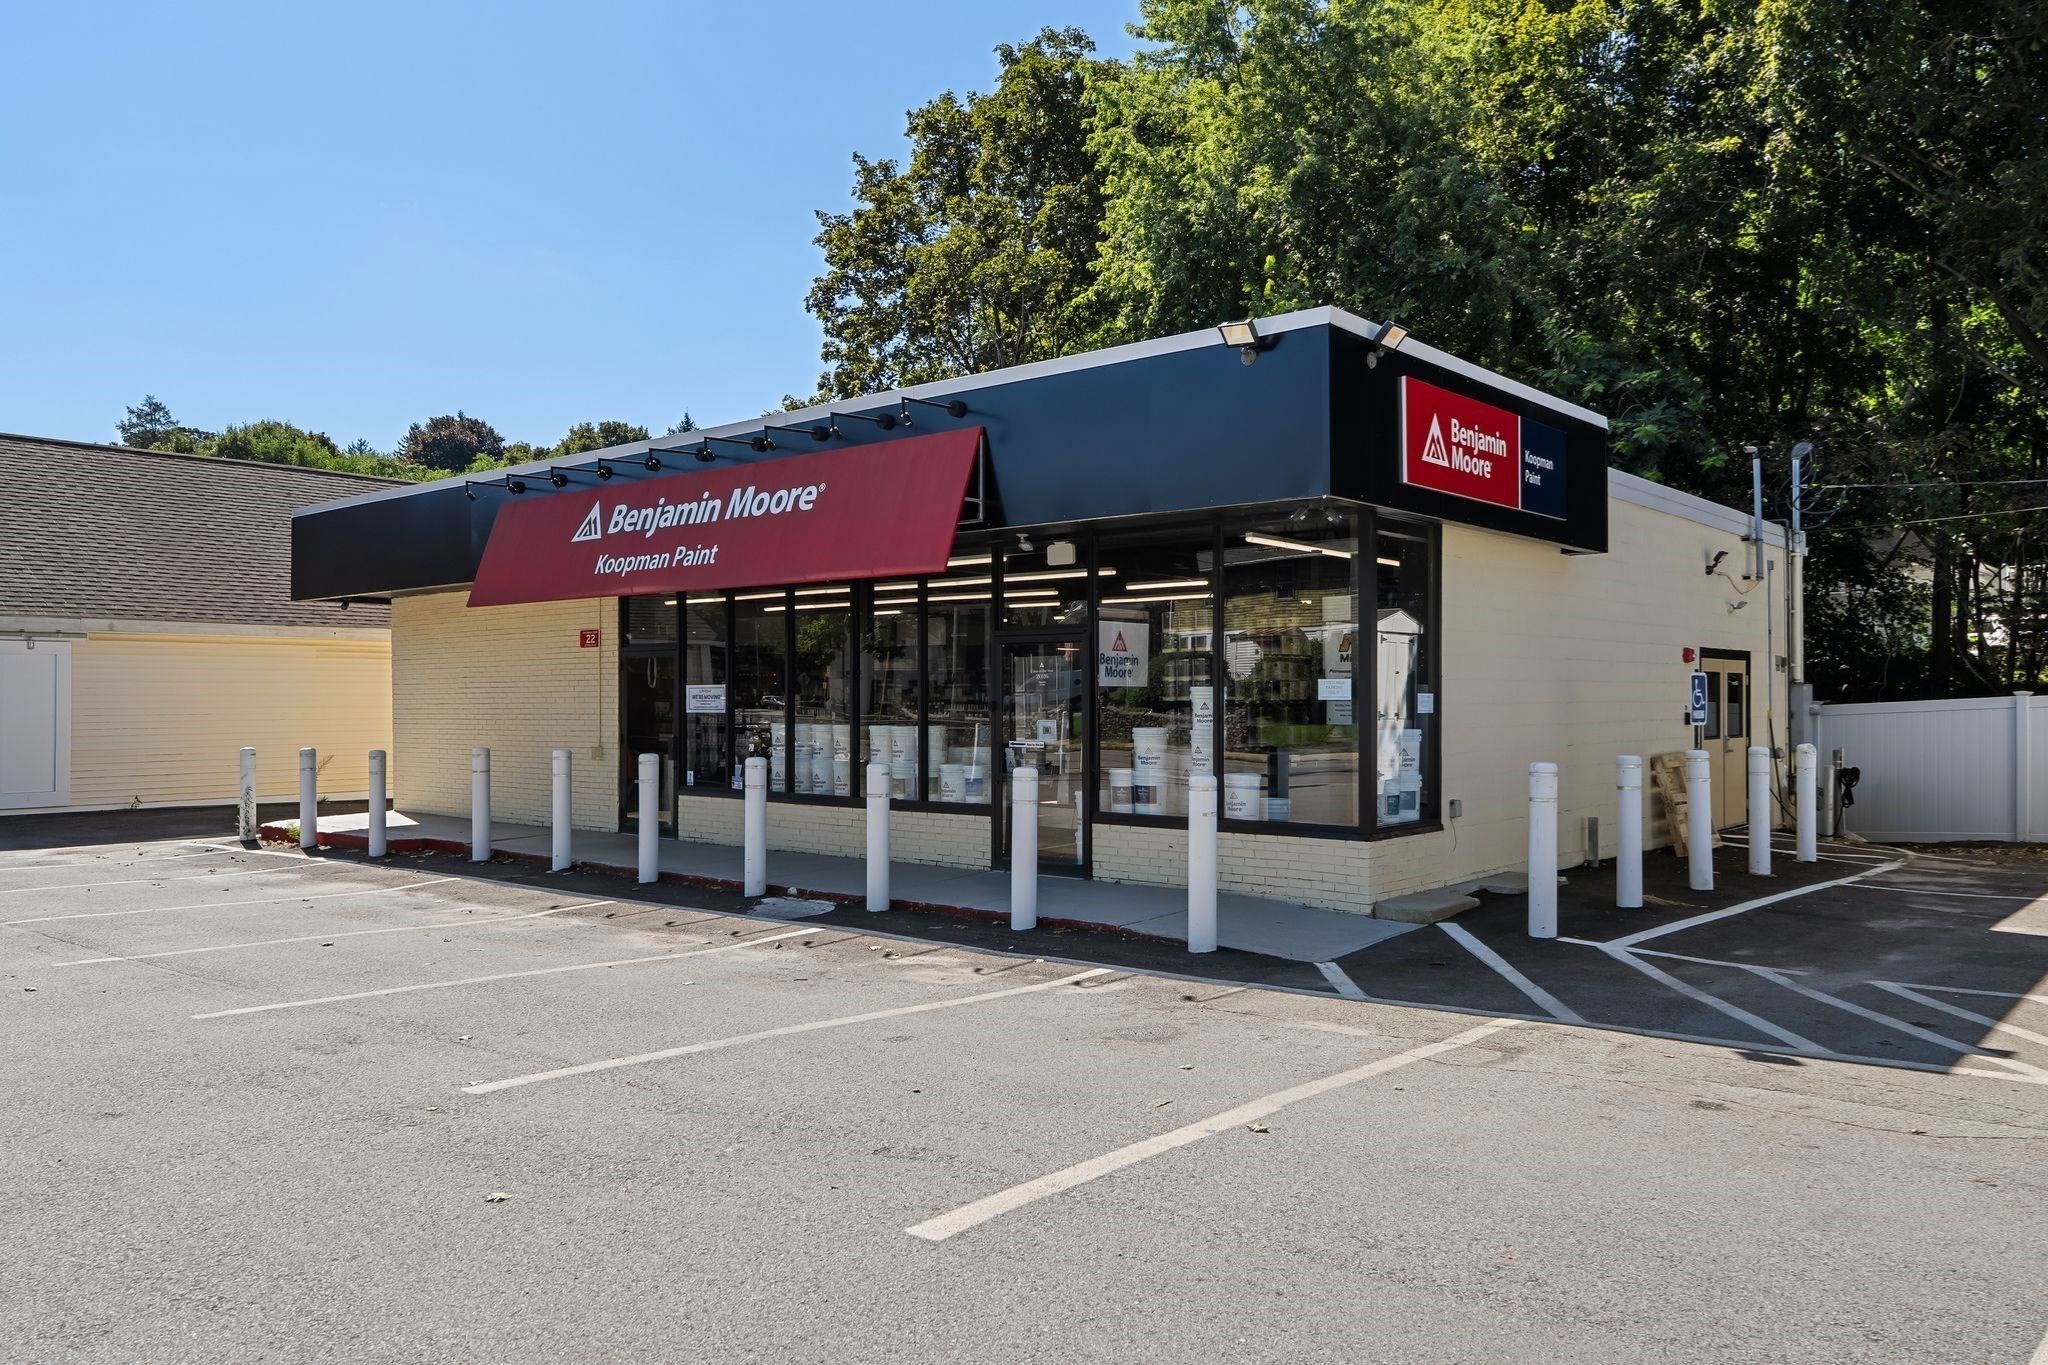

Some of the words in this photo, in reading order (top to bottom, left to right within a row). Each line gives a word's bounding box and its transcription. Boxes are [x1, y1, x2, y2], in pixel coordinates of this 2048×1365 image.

[1450, 418, 1507, 458] Benjamin
[1451, 445, 1492, 479] Moore
[1524, 450, 1555, 471] Koopman
[1524, 469, 1541, 487] Paint
[607, 491, 722, 538] Benjamin
[594, 550, 670, 577] Koopman
[672, 543, 719, 569] Paint
[585, 634, 596, 644] 22
[1099, 652, 1139, 668] Benjamin
[1104, 665, 1133, 678] Moore
